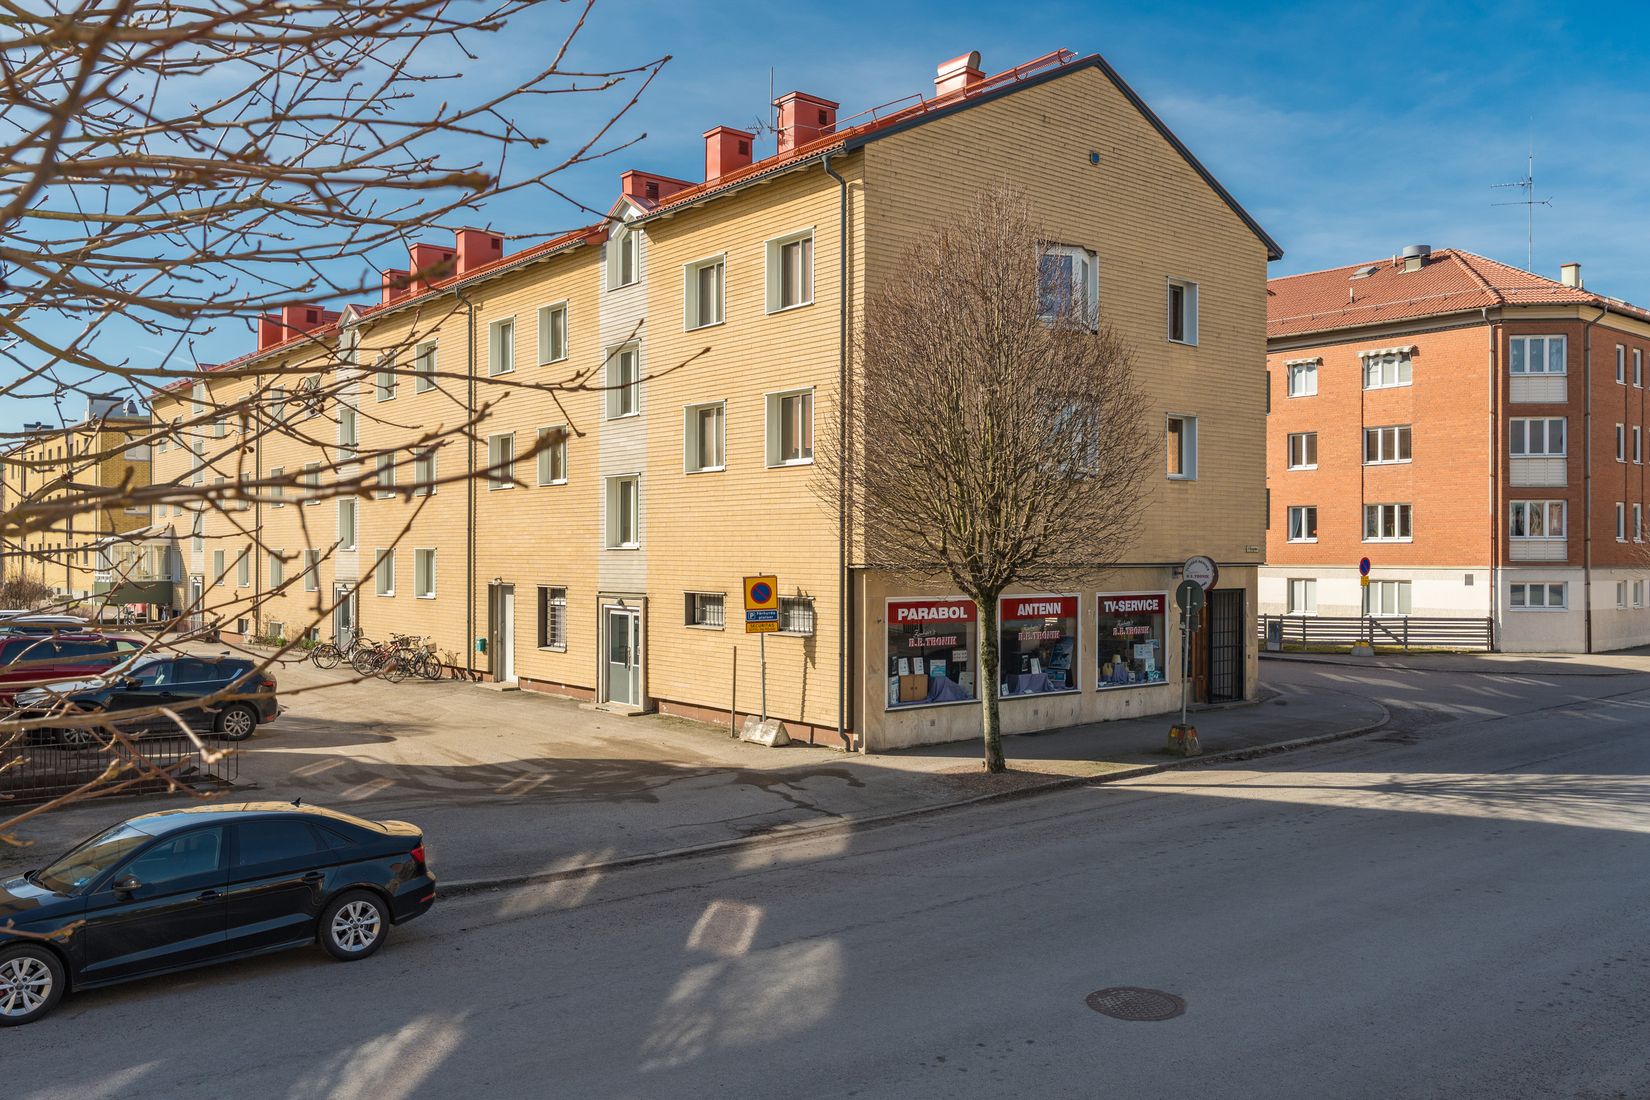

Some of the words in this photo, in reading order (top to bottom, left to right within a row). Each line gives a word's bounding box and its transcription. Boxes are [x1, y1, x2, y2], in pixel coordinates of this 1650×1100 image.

[1017, 602, 1061, 616] ANTENN
[1103, 599, 1159, 612] TV-SERVICE
[897, 606, 968, 620] PARABOL
